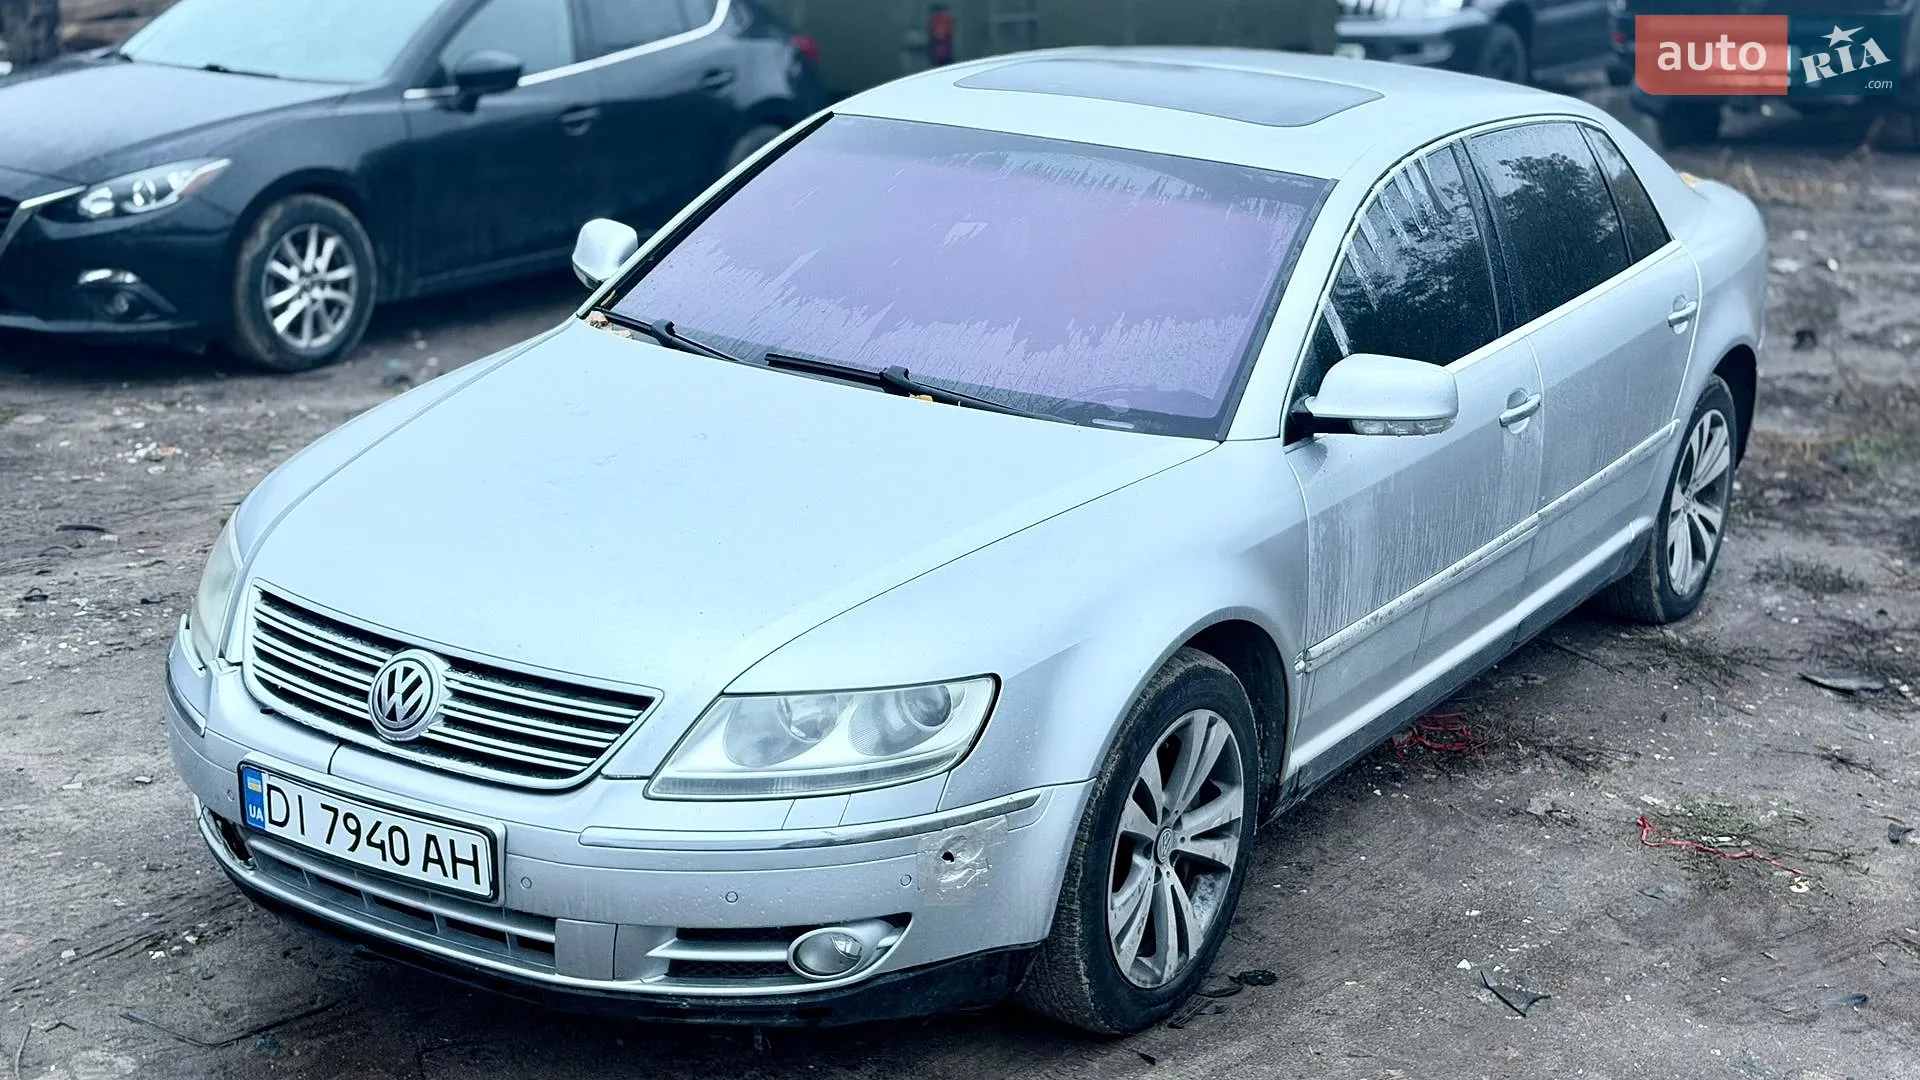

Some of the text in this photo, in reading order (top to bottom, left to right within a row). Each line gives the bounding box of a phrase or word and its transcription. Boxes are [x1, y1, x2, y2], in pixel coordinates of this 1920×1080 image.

[248, 804, 264, 822] UA
[266, 784, 481, 886] DI 7940 AH
